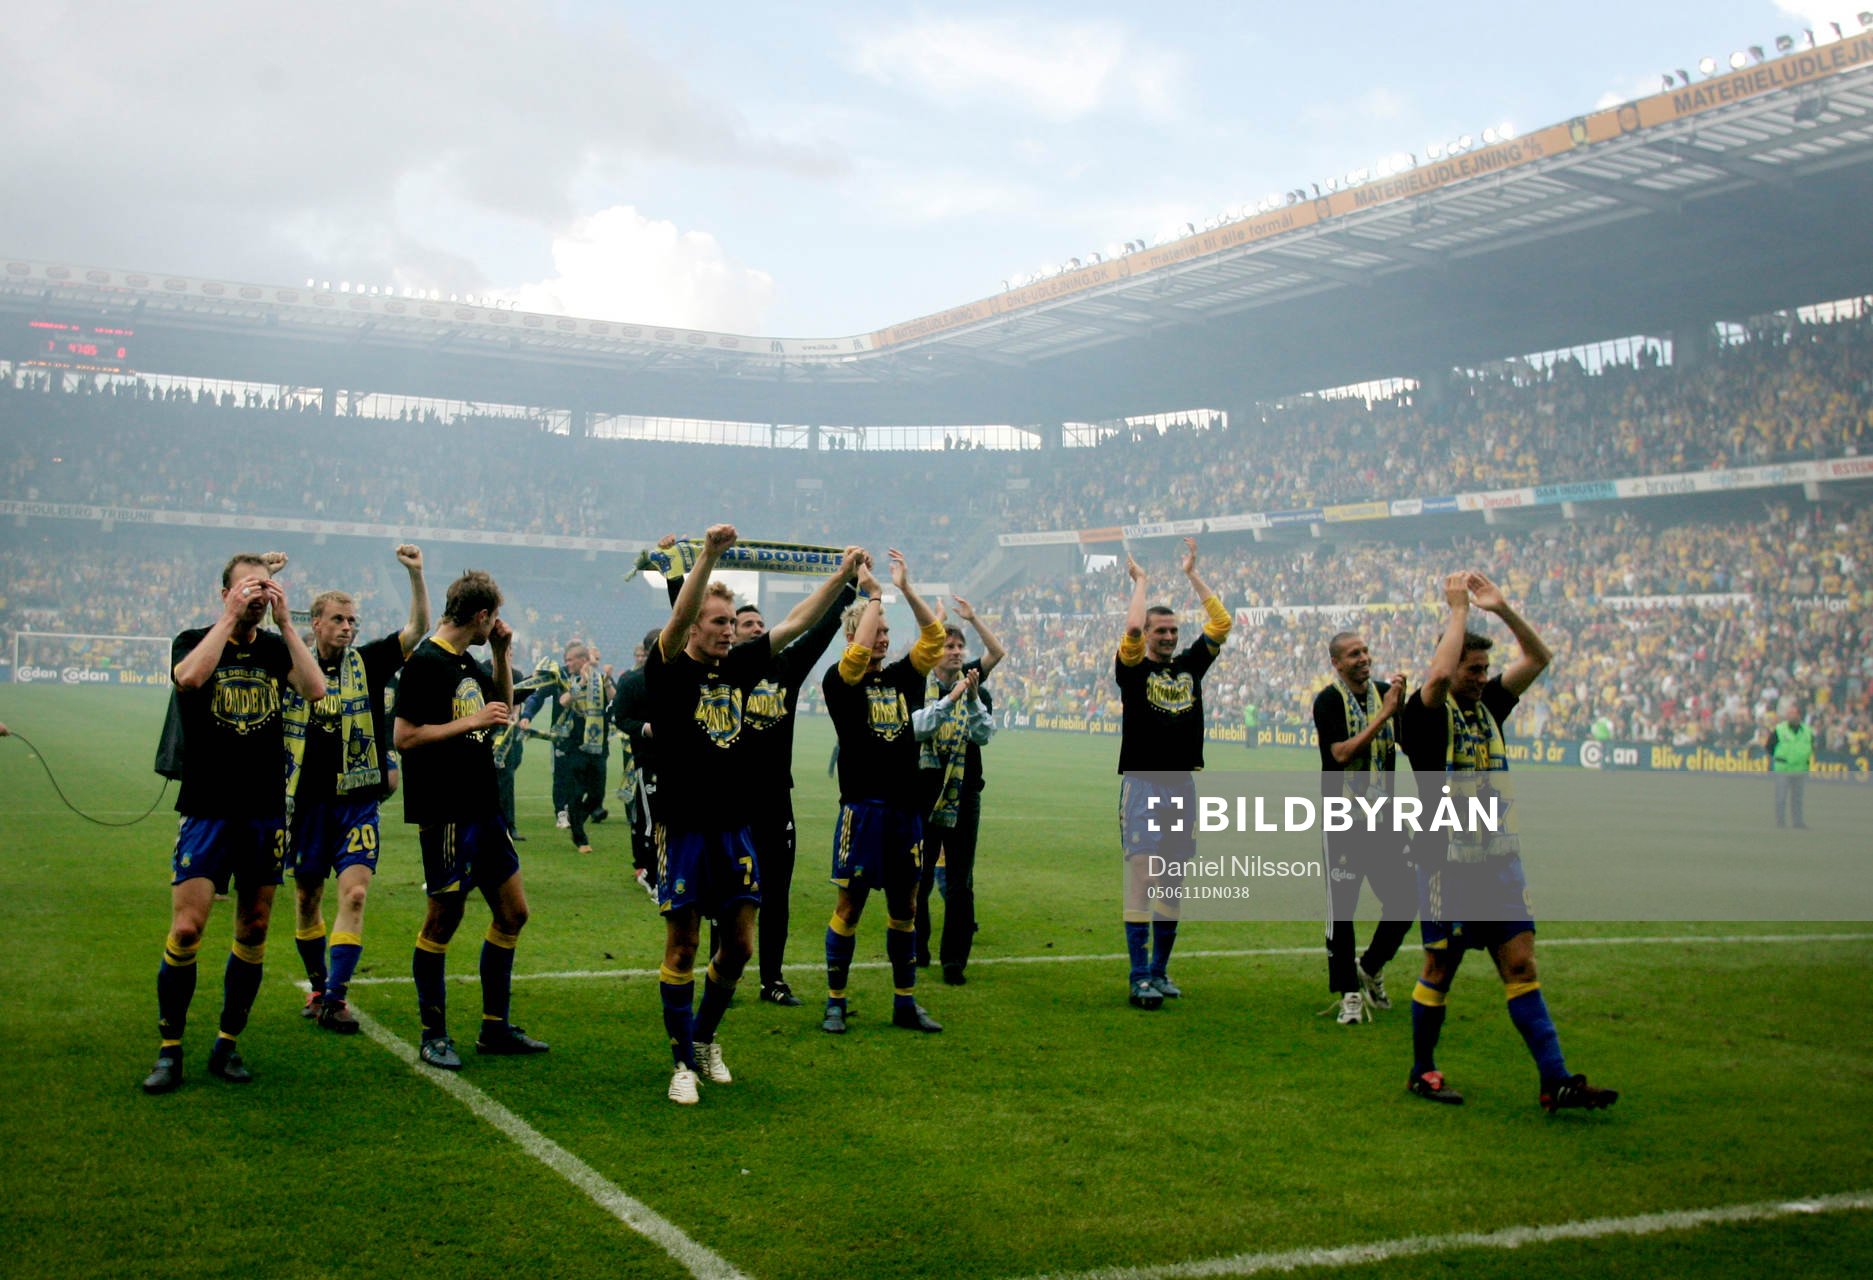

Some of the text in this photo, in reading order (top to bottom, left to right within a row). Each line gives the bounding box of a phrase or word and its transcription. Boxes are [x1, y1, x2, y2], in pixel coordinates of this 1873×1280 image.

[1354, 144, 1522, 206] MATERIELUDLEJNING
[721, 548, 752, 561] HE
[18, 666, 57, 681] Codan
[62, 667, 109, 684] Codan
[120, 670, 143, 683] Bliv
[1209, 720, 1246, 741] elitebili
[1258, 726, 1272, 745] på
[1275, 725, 1296, 744] kun
[1299, 728, 1308, 746] 3
[1506, 740, 1566, 762] un 3 år
[1651, 744, 1682, 769] Bliv
[1855, 756, 1869, 782] 3
[273, 828, 284, 858] 3
[346, 823, 377, 853] 20
